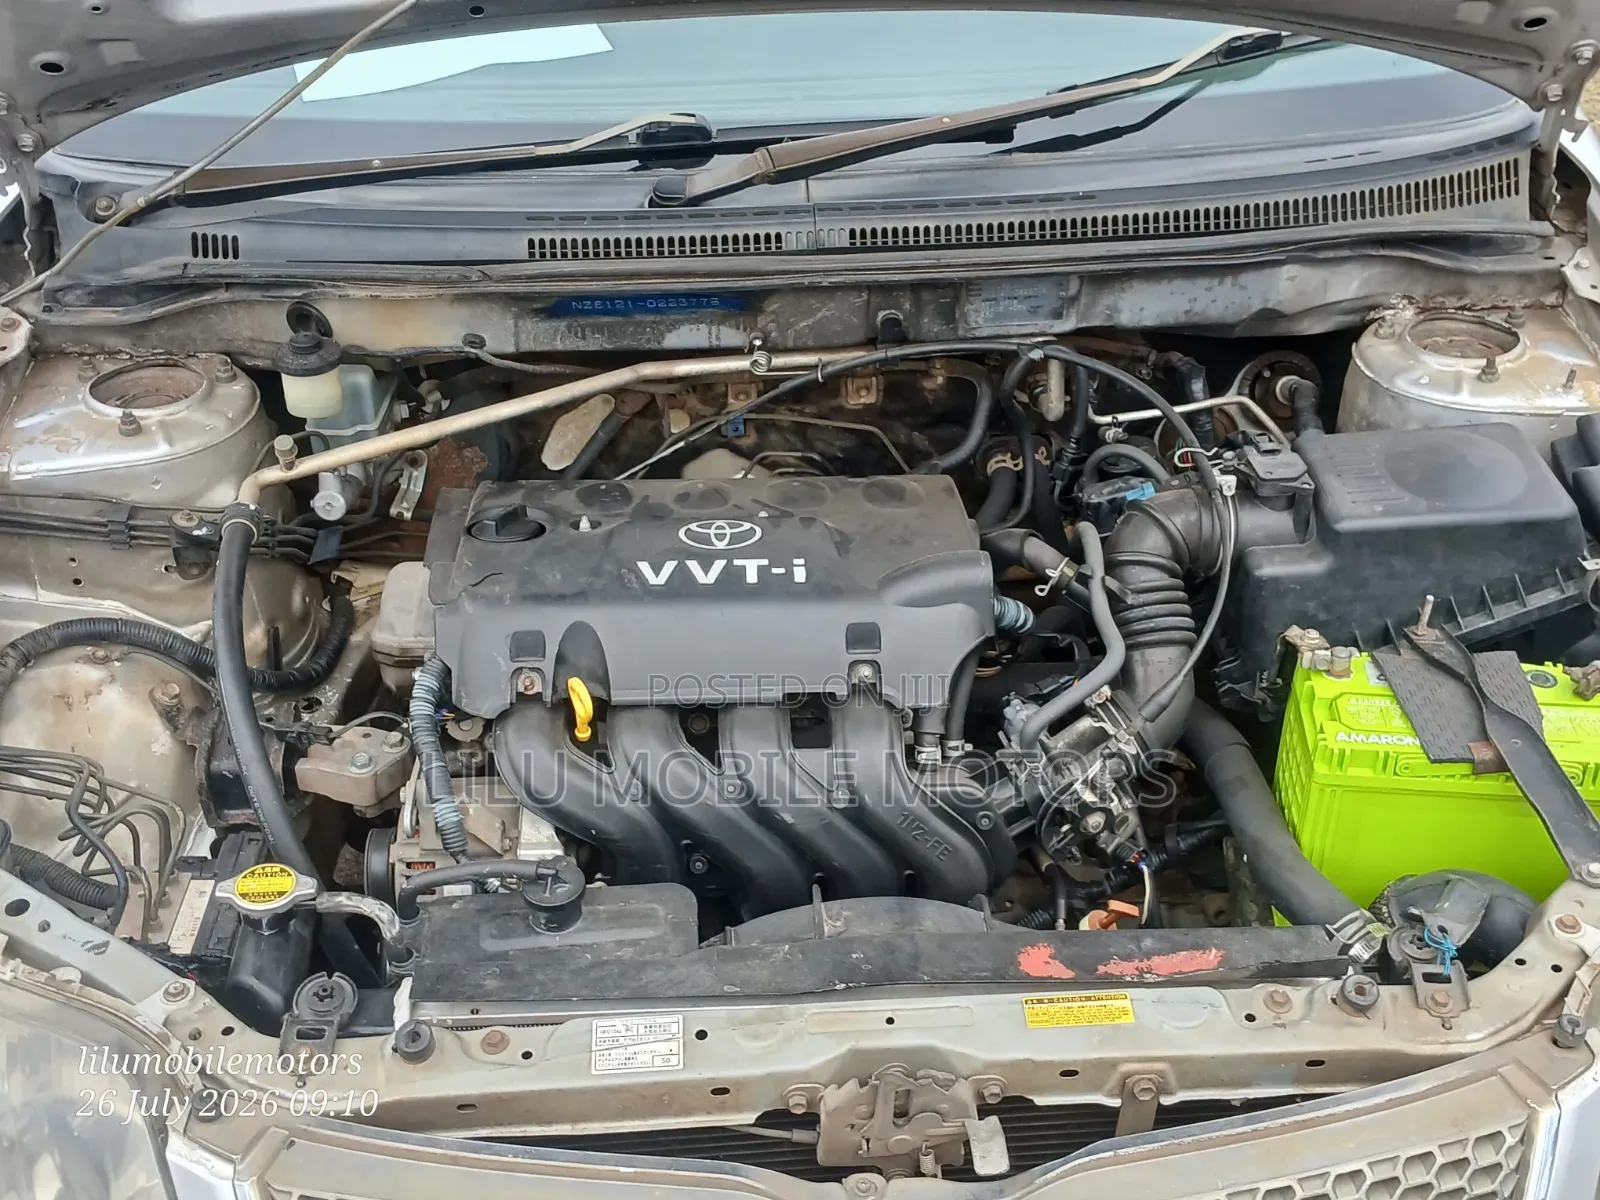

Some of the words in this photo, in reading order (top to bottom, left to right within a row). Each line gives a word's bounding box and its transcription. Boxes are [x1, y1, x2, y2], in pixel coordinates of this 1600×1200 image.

[636, 558, 807, 585] VVT-i
[1336, 731, 1420, 746] AMARON
[246, 871, 288, 879] CAUTION
